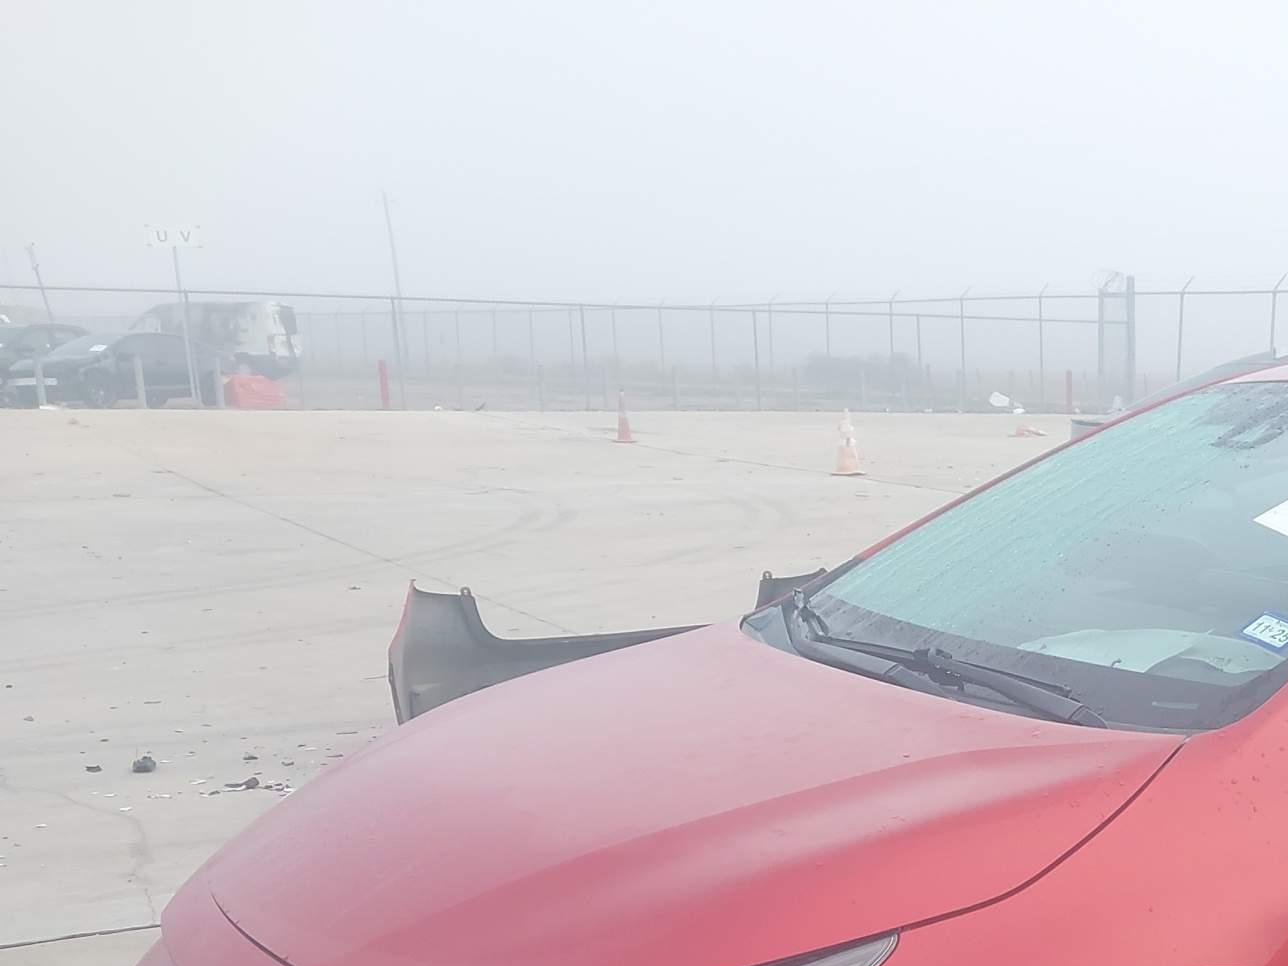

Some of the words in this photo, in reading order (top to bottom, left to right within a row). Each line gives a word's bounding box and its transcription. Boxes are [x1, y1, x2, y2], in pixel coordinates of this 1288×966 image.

[155, 230, 168, 243] U
[179, 230, 191, 243] V
[1252, 621, 1271, 634] 11
